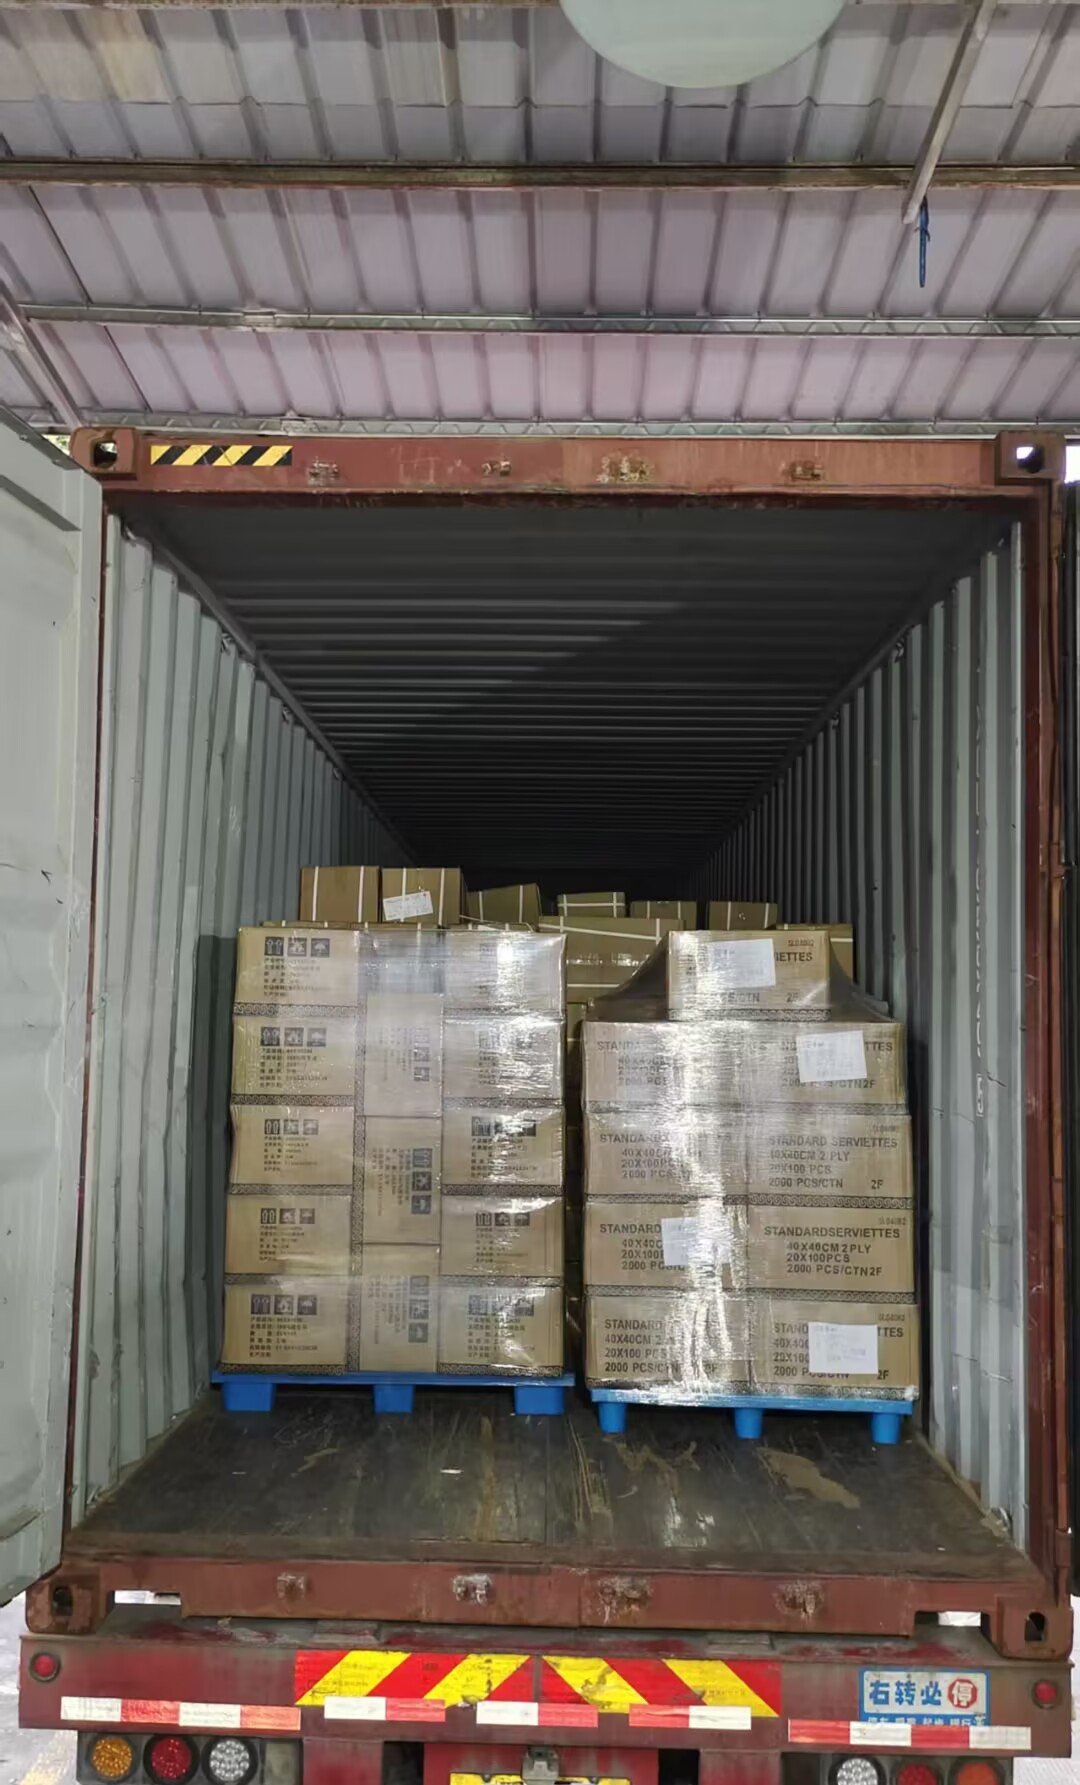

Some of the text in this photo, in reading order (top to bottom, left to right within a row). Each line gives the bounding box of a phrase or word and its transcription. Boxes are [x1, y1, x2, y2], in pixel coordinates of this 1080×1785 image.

[768, 1135, 898, 1148] STANDARD SERVIETTES
[830, 1152, 850, 1162] PLY
[809, 1165, 832, 1174] PCS
[769, 1178, 884, 1189] 2000 PCS/CTN 2F
[600, 1224, 661, 1234] STANDARD
[622, 1239, 662, 1249] 40X40C
[786, 1242, 839, 1252] 40X40CM
[787, 1253, 850, 1263] 20X100PCS
[622, 1261, 646, 1270] 2000
[787, 1264, 811, 1273] 2000
[605, 1348, 641, 1358] 20X100
[605, 1362, 629, 1372] 2000
[773, 1366, 797, 1376] 2000
